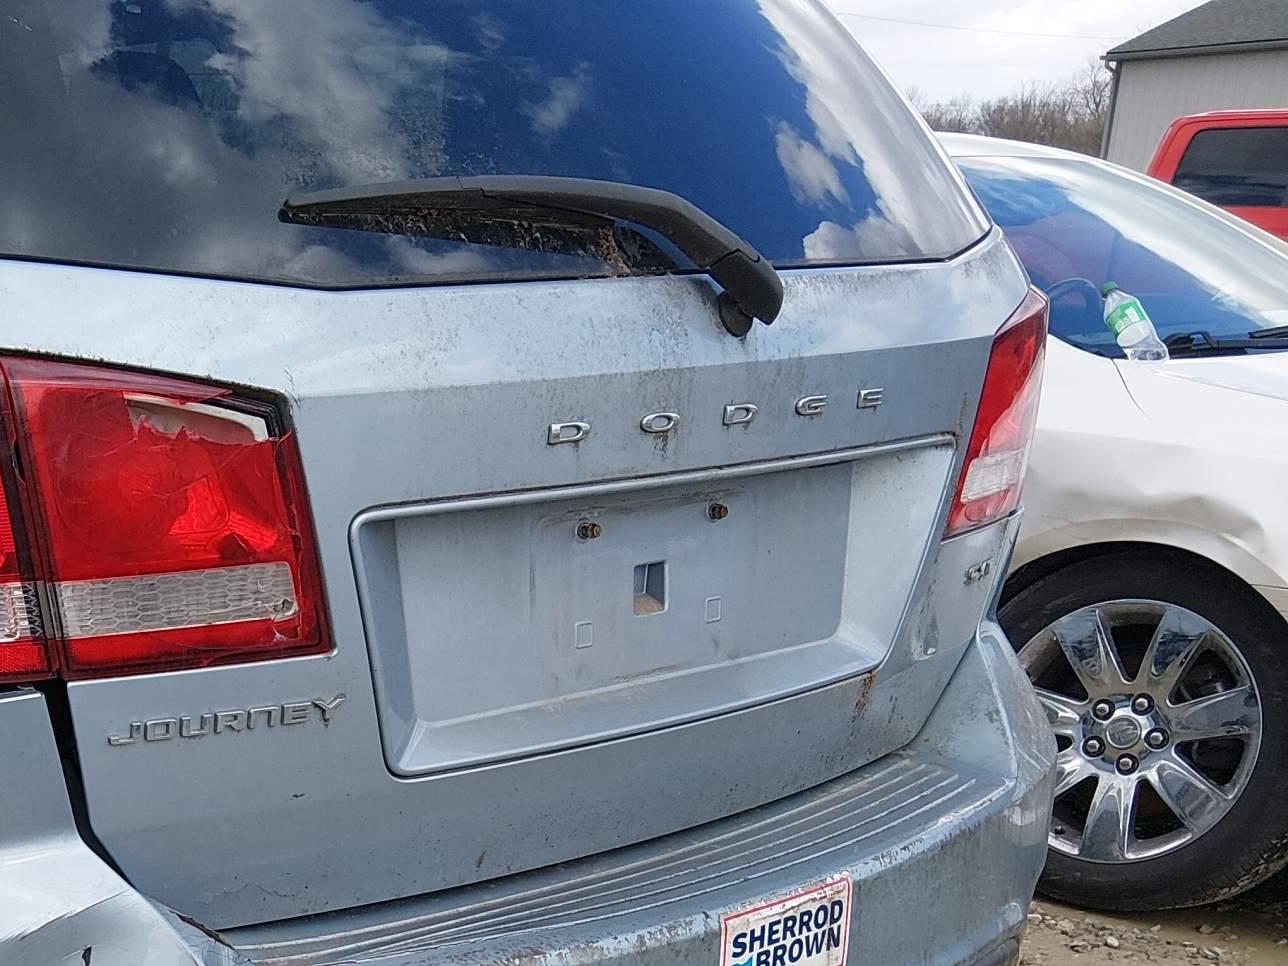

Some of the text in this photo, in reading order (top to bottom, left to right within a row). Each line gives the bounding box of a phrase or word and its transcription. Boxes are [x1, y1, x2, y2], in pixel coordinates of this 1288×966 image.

[548, 387, 884, 445] DODGE
[107, 693, 346, 746] JOURNEY
[731, 899, 844, 959] SHERROD
